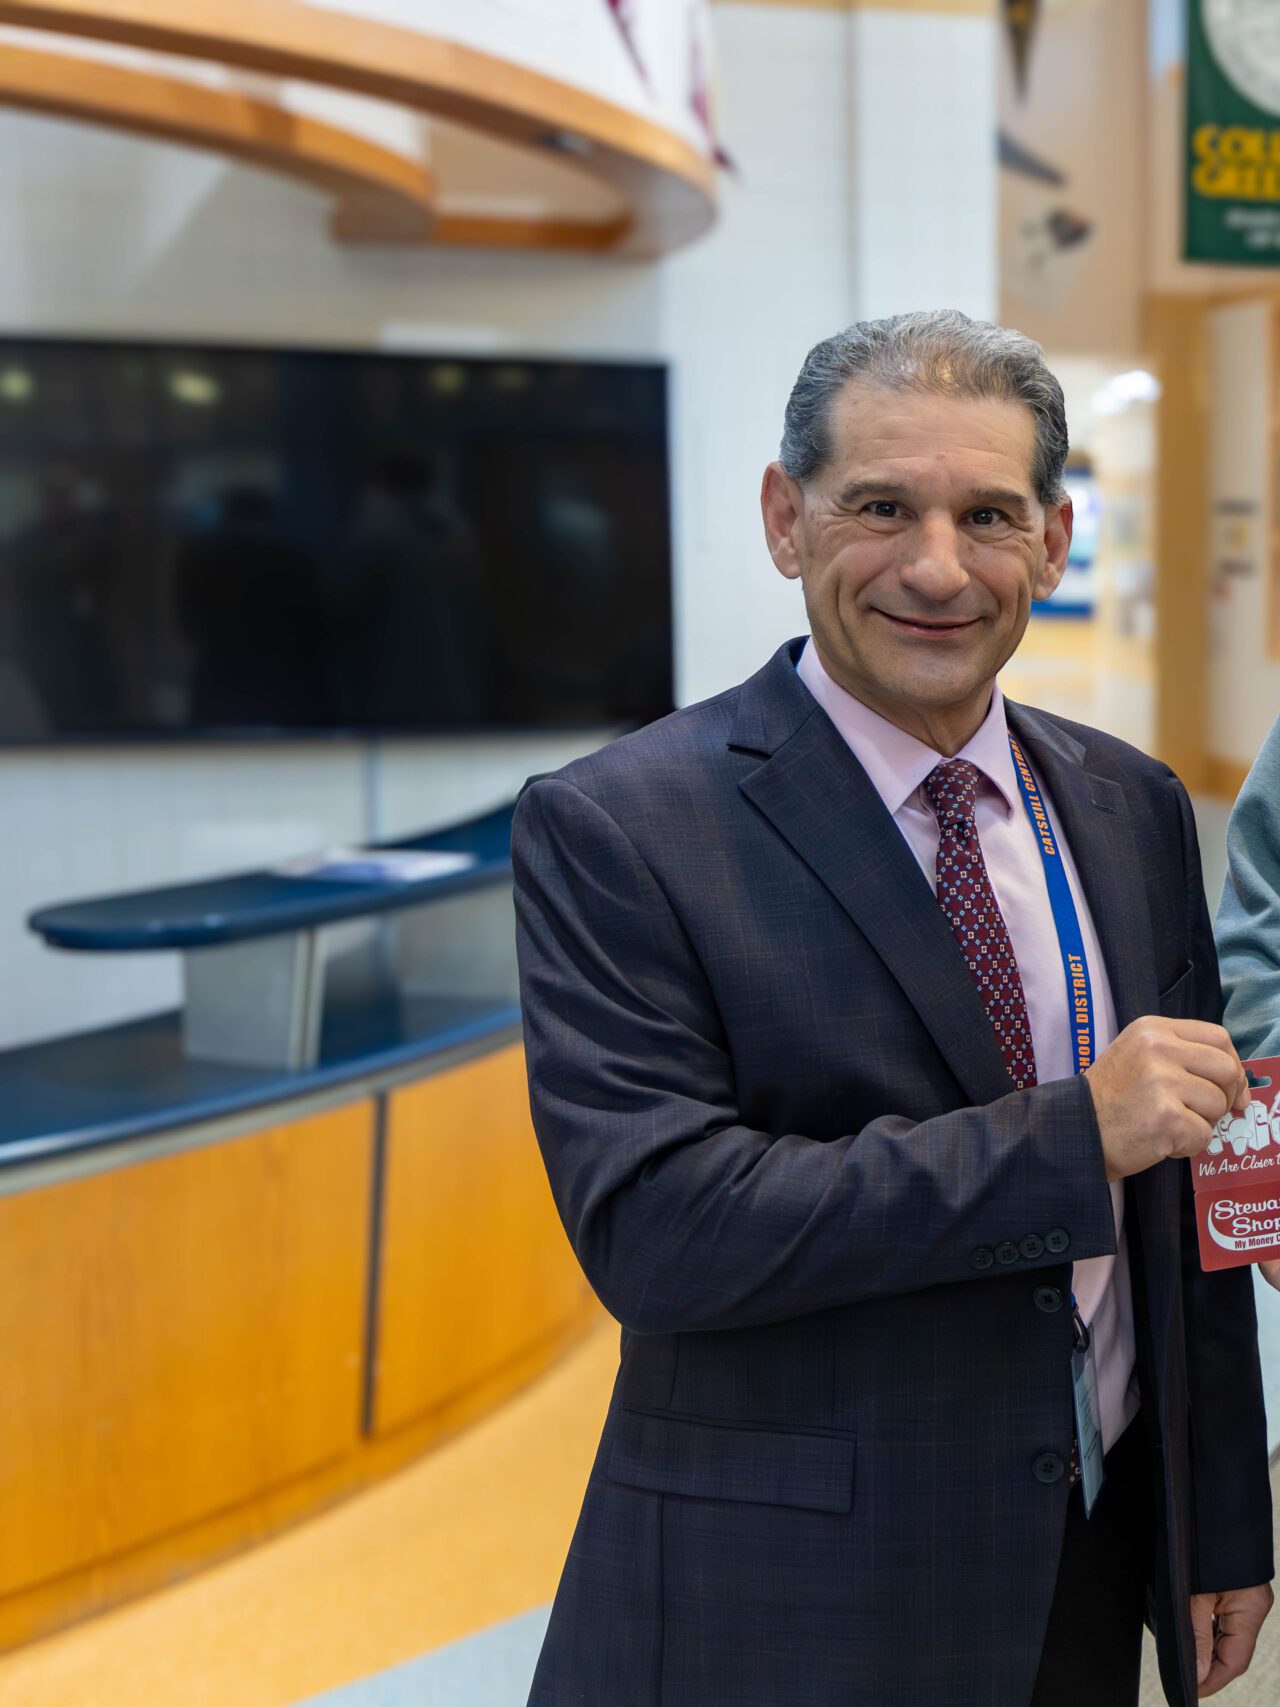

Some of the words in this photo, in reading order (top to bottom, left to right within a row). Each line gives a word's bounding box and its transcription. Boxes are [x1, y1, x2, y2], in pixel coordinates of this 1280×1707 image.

[1029, 795, 1055, 855] CATSKILL
[1068, 953, 1089, 1023] DISTRICT
[1077, 1027, 1091, 1073] HOOL
[1199, 1161, 1216, 1176] We
[1218, 1159, 1239, 1174] Are
[1240, 1154, 1274, 1170] Closer
[1234, 1240, 1246, 1249] My
[1248, 1235, 1274, 1247] Money
